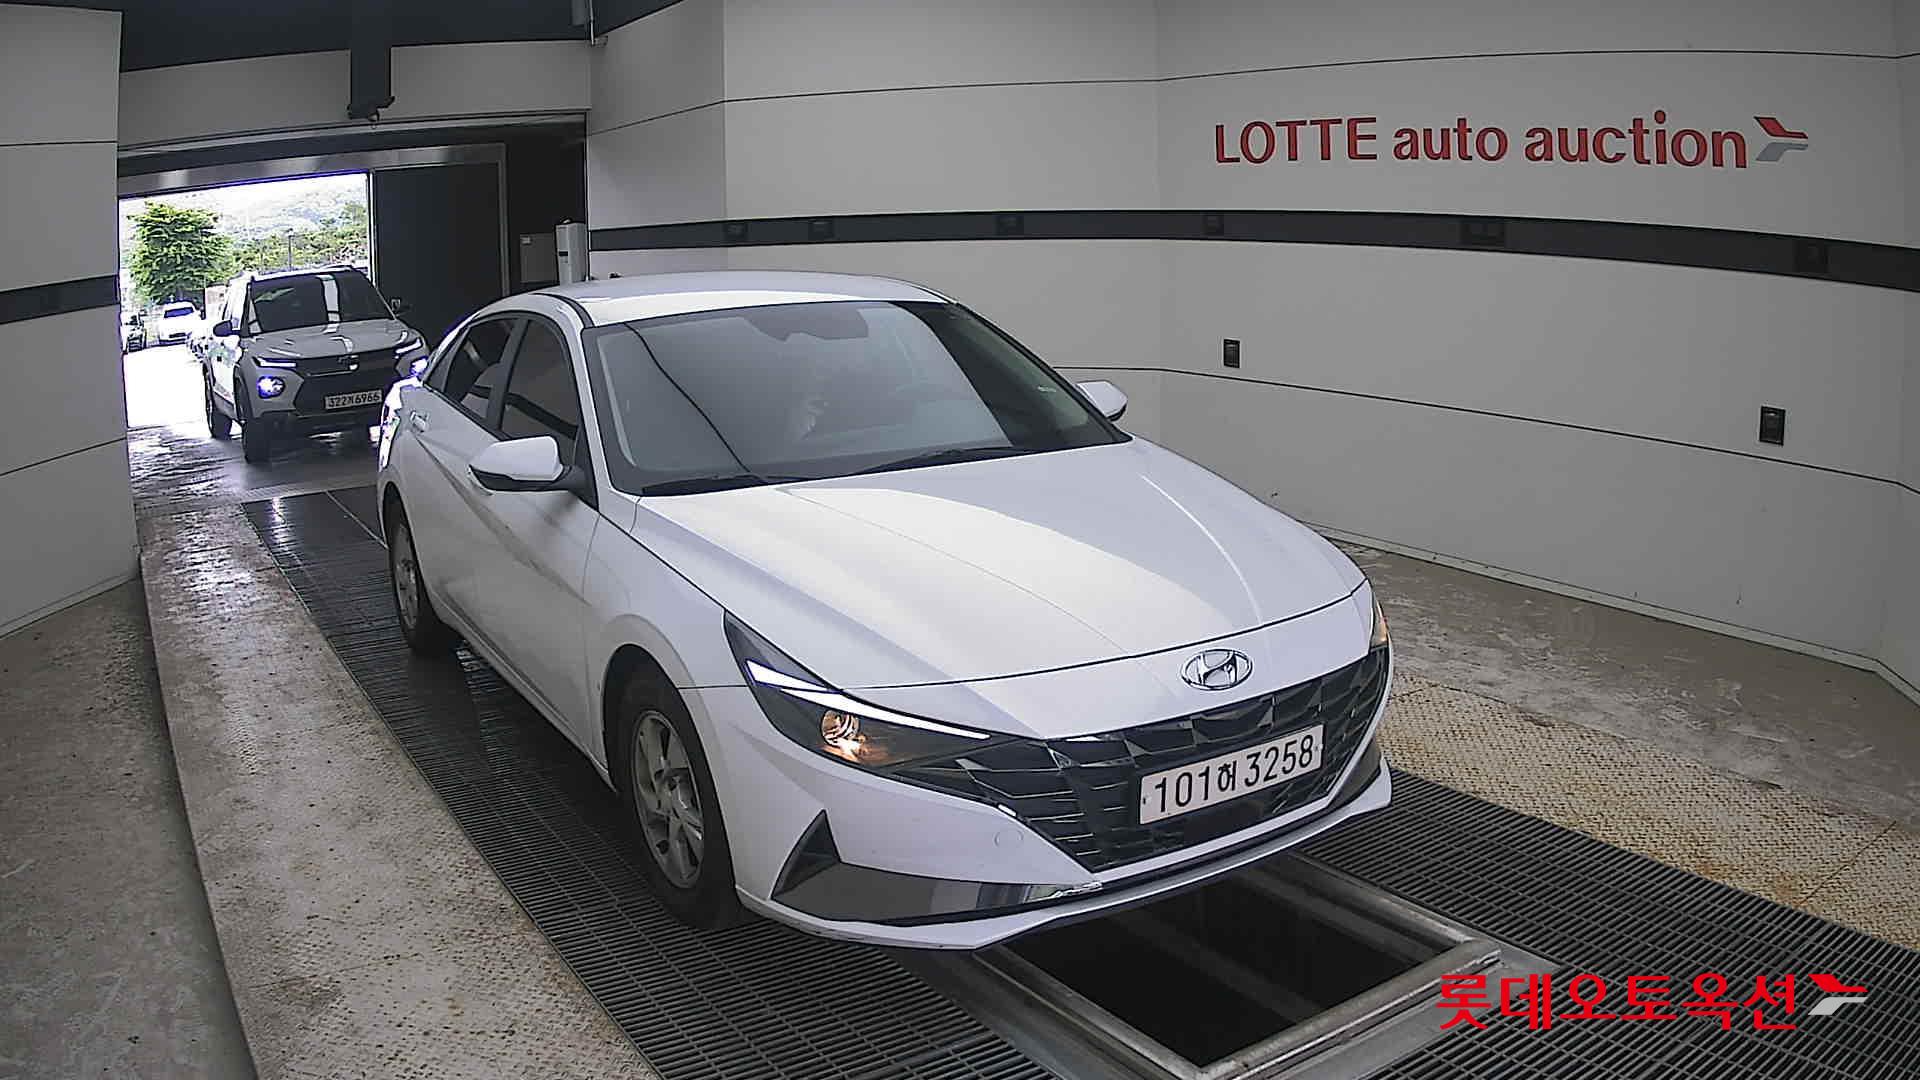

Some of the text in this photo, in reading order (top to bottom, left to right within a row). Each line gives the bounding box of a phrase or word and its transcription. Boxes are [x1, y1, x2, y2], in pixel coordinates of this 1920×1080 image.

[1215, 110, 1747, 168] LOTTE auto auction
